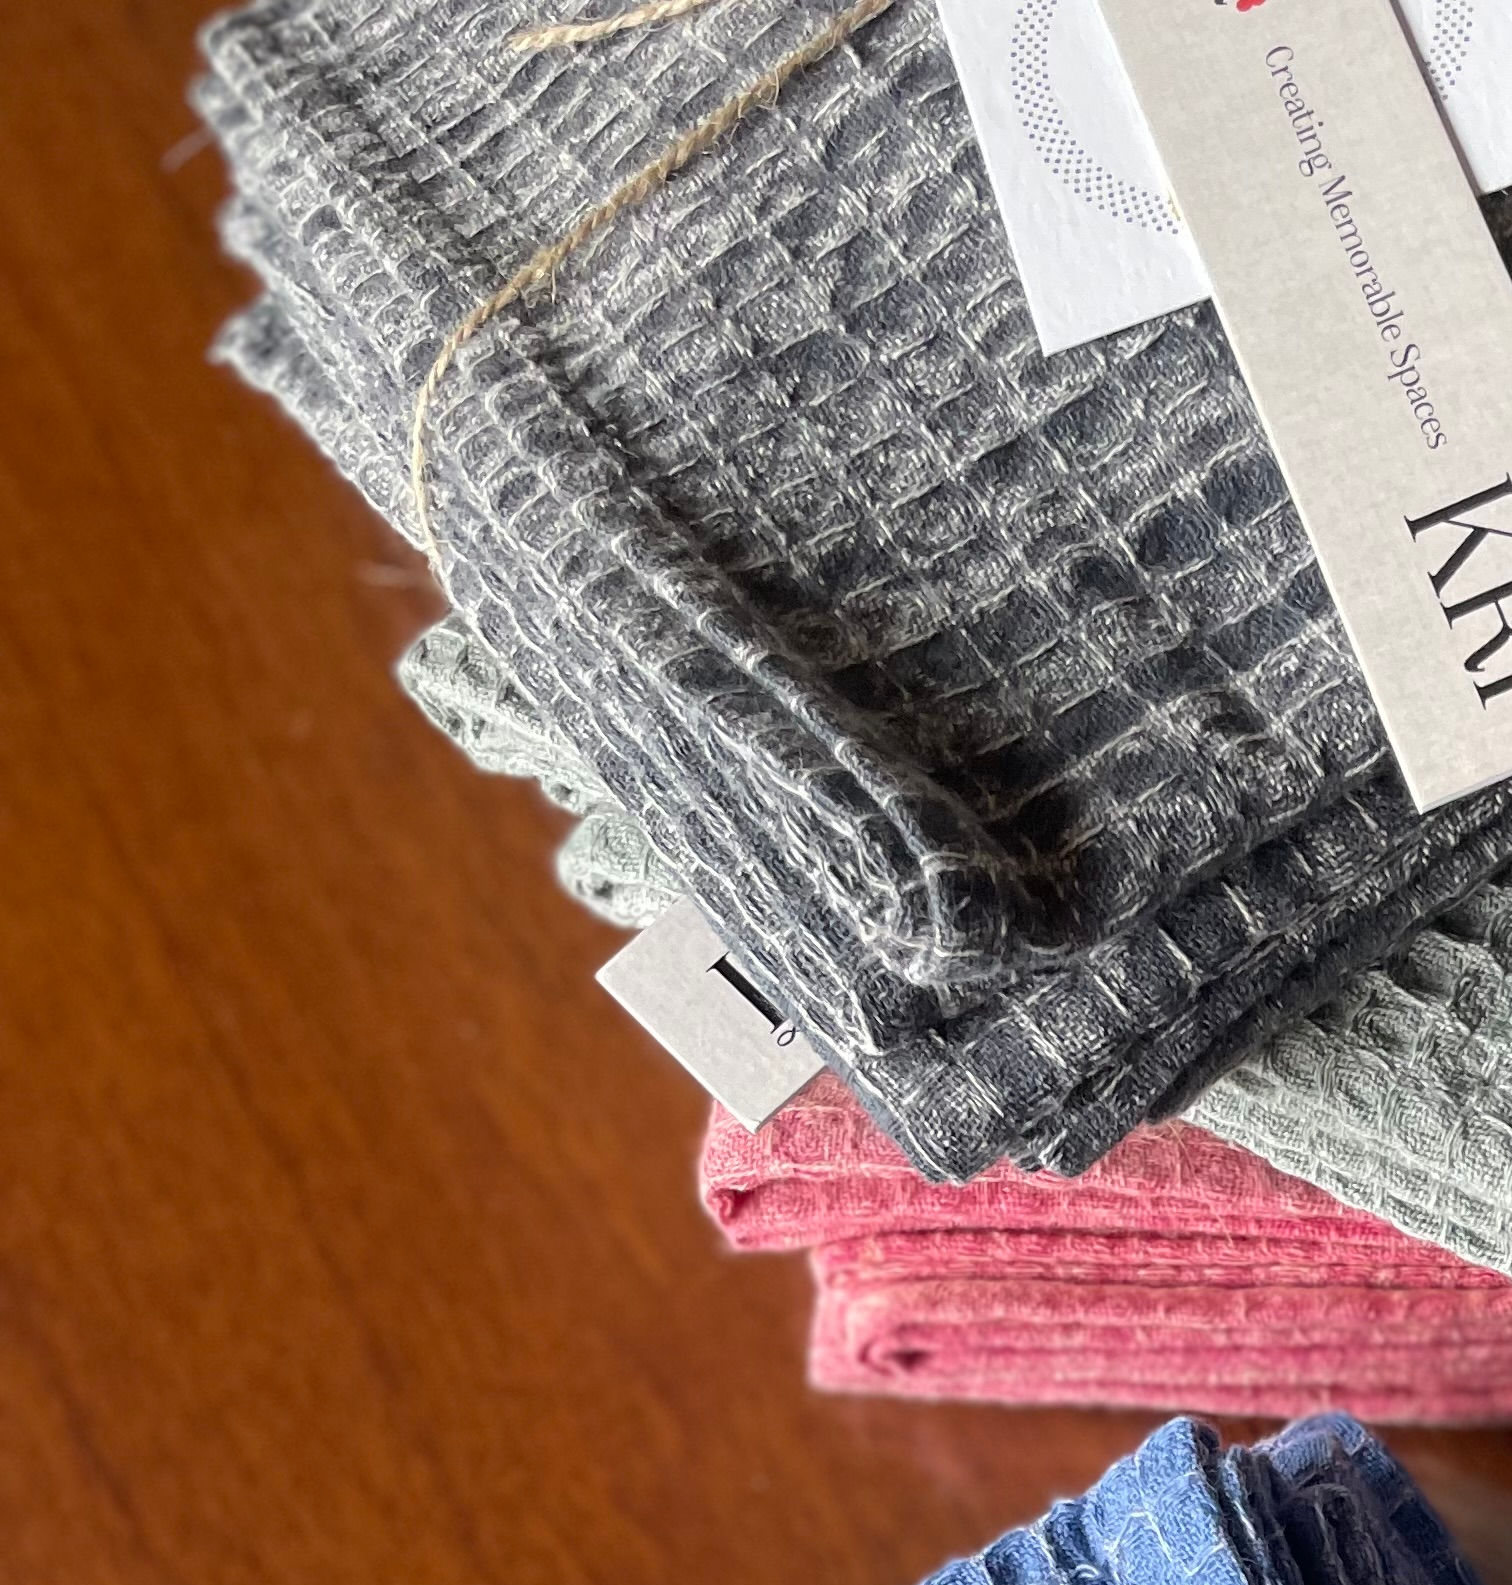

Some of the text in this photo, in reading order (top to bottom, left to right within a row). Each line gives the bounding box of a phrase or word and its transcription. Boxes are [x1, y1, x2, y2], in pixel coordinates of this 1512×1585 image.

[1265, 46, 1447, 450] Creating Memorable Spaces
